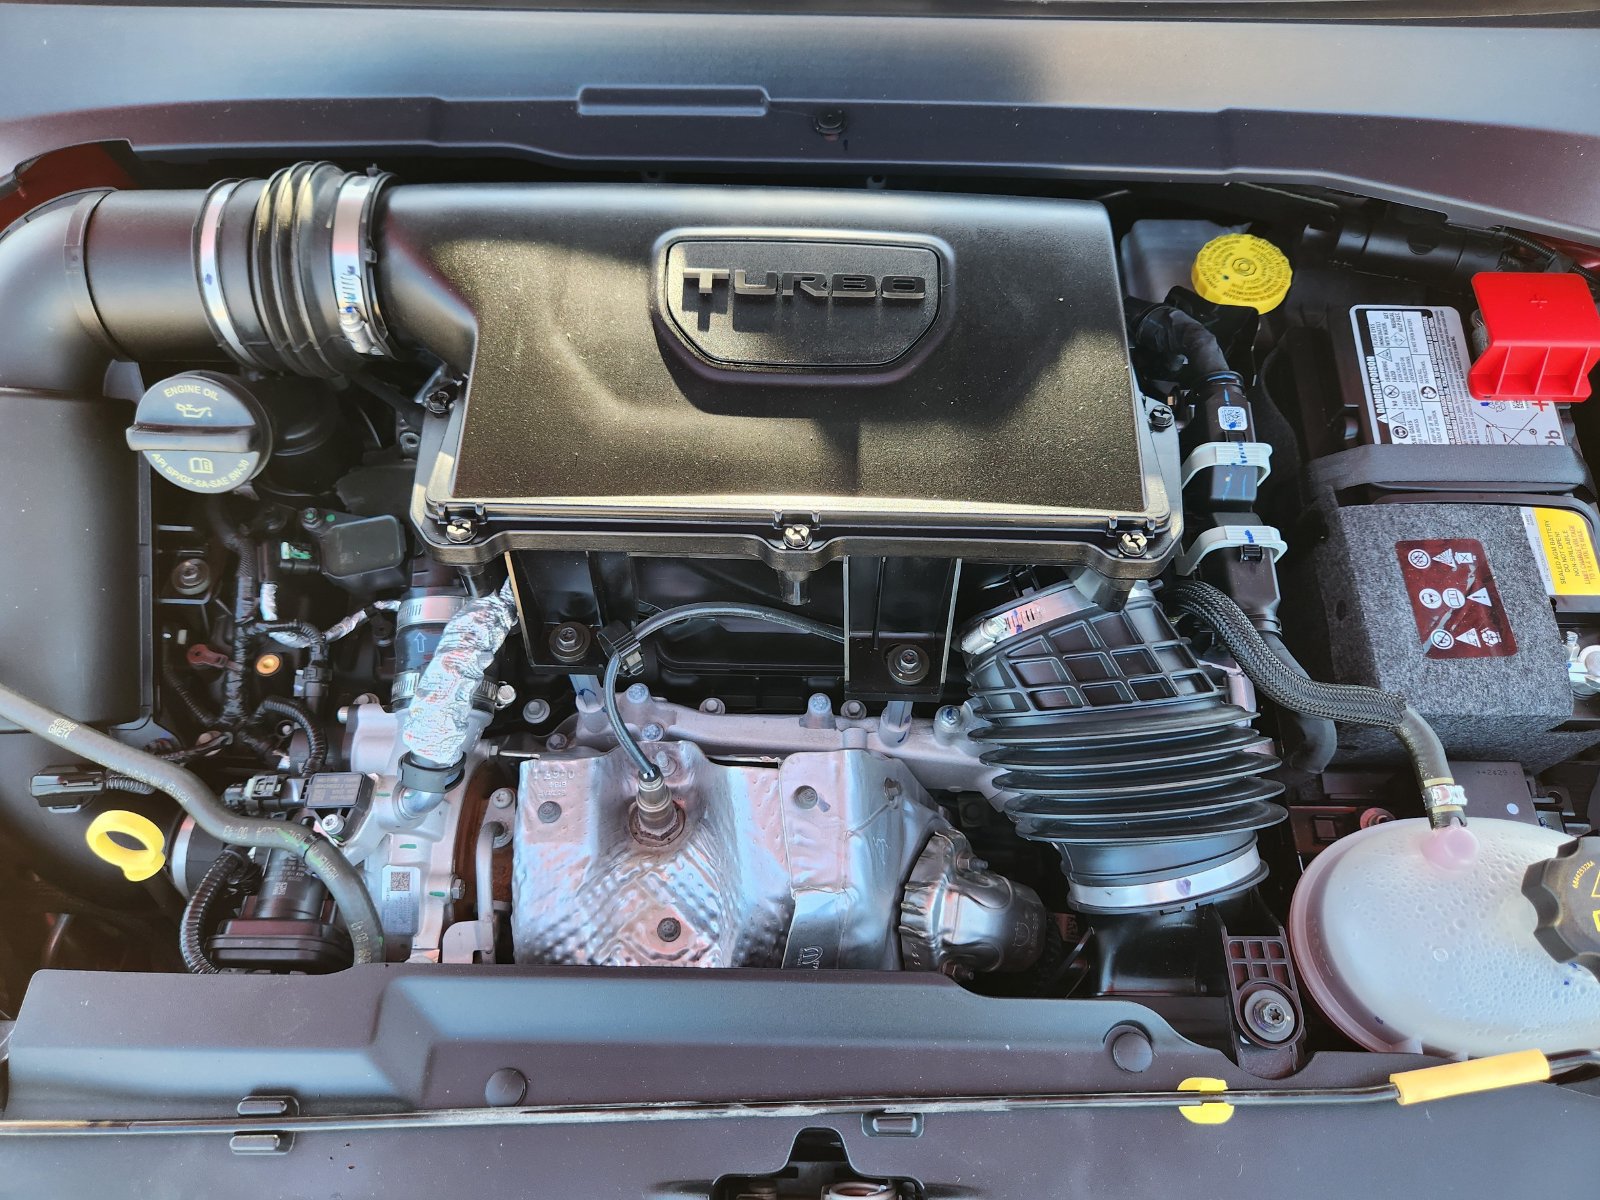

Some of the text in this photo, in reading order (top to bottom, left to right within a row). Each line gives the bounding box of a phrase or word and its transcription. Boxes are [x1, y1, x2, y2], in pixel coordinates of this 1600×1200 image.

[683, 268, 926, 299] TURBO
[164, 384, 218, 400] ENGINE OIL
[151, 453, 168, 468] API
[228, 458, 249, 481] 5W-30
[1543, 519, 1555, 545] BATTERY
[1551, 546, 1559, 560] AGM
[1559, 550, 1567, 562] NOT
[1555, 560, 1566, 584] SEALED
[1563, 563, 1570, 572] DO
